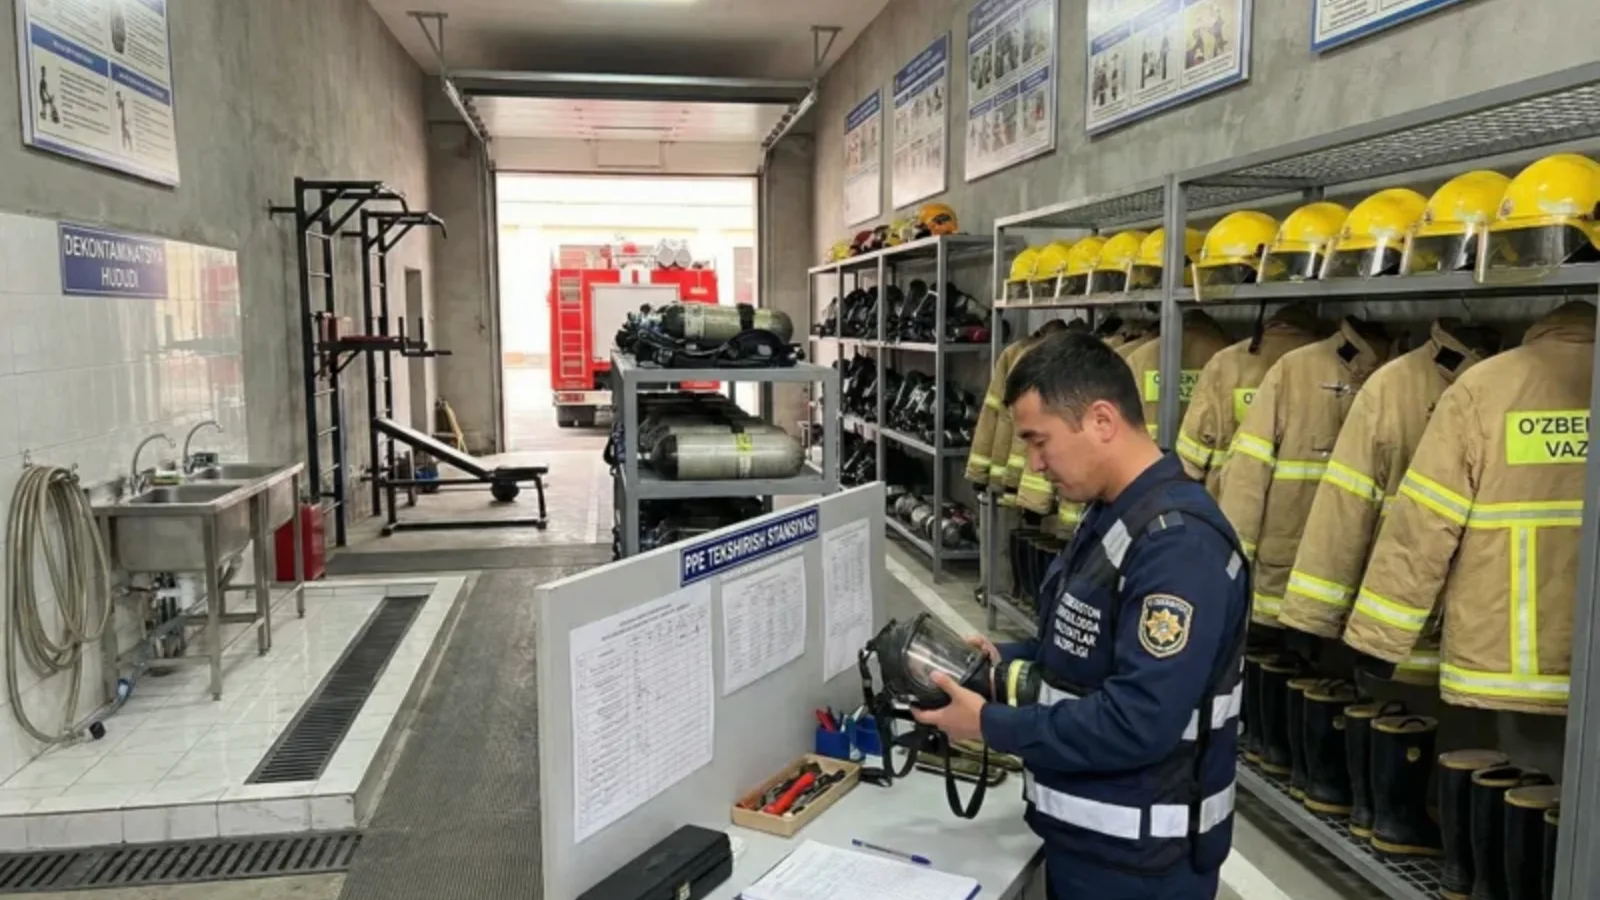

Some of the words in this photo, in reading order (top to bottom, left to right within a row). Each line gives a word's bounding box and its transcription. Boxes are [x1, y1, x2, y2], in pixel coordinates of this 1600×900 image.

[101, 267, 139, 288] HUDUDI
[685, 551, 706, 575] PPE
[708, 532, 767, 567] TEKSHIRISH
[767, 513, 817, 547] STANSIYASI
